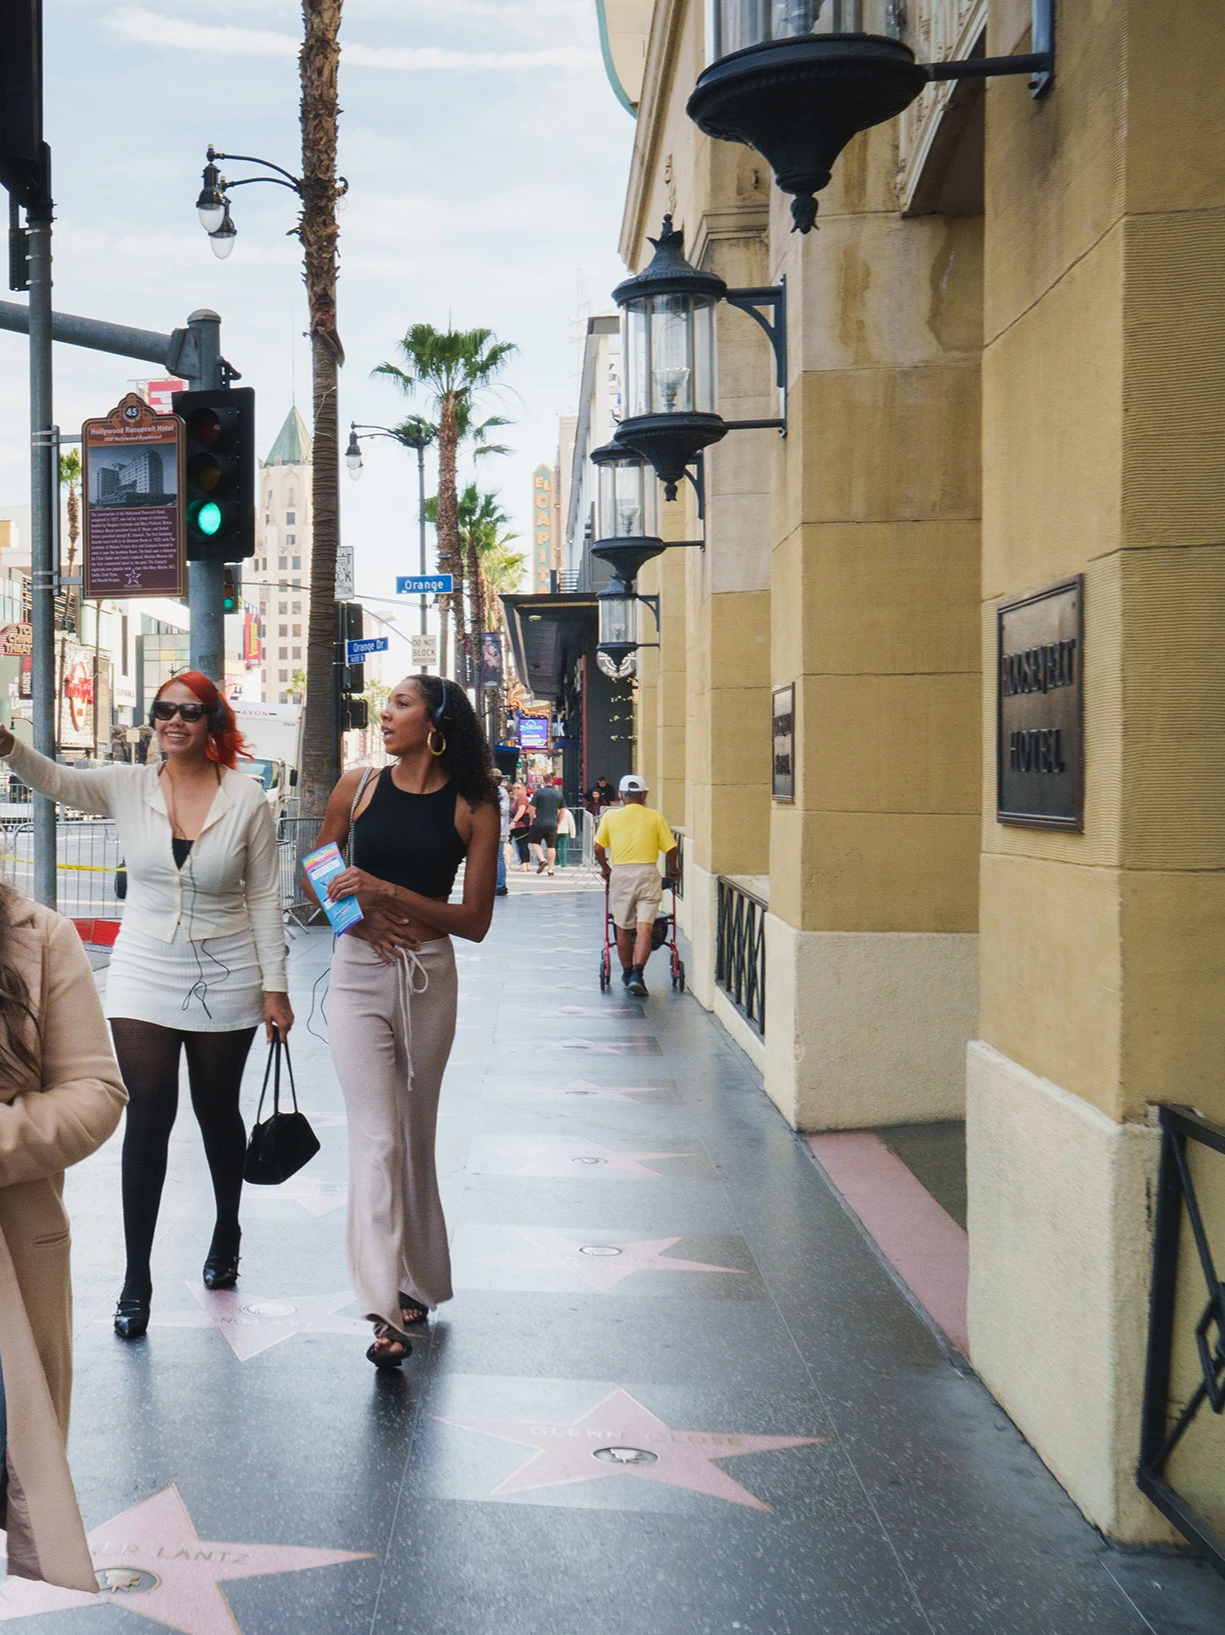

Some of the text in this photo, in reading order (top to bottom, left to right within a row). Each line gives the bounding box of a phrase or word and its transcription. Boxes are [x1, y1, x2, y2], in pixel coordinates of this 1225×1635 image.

[126, 408, 137, 417] 45
[90, 424, 174, 436] Hollywood Roosevelt Hotel
[535, 493, 551, 594] CAPIT
[404, 580, 444, 592] Orange
[353, 639, 385, 653] Orange Dr
[413, 648, 435, 657] BLOCK
[241, 709, 268, 717] AVON
[1009, 728, 1066, 773] HOTEL
[530, 1426, 743, 1447] GLENN CLOSE
[156, 1546, 250, 1564] LANTZ
